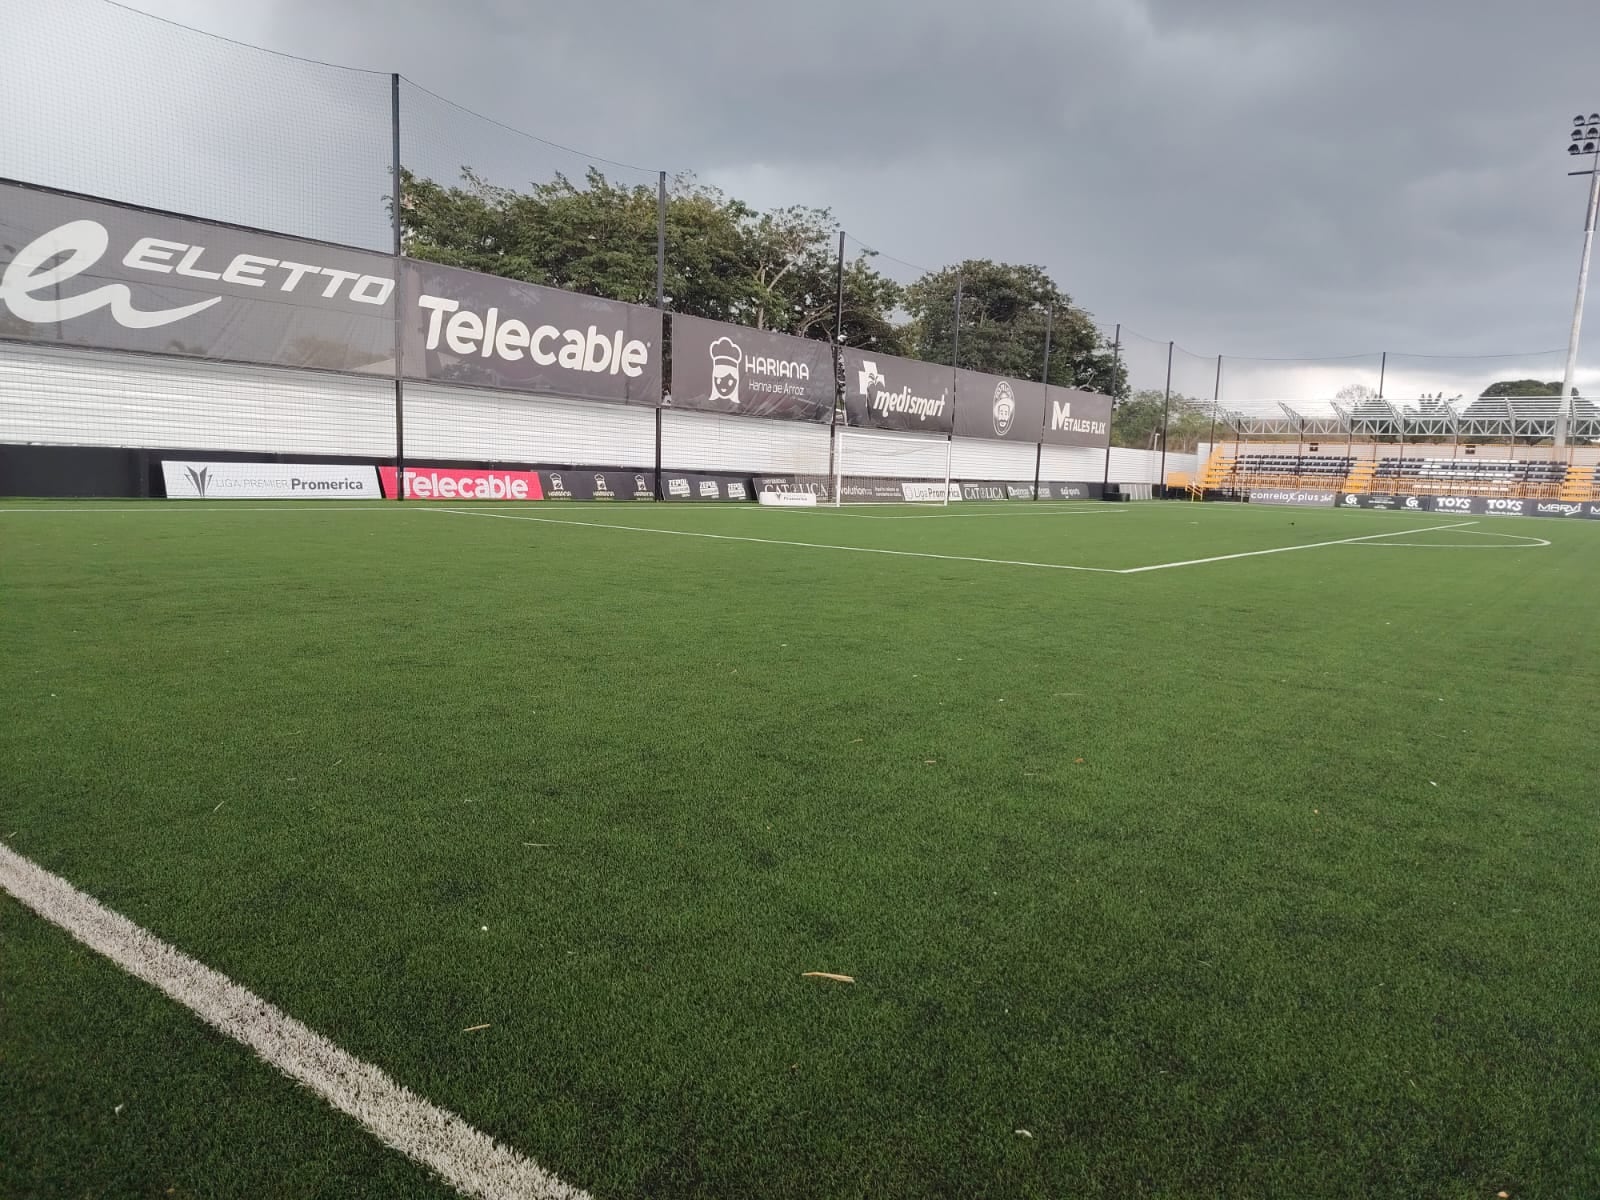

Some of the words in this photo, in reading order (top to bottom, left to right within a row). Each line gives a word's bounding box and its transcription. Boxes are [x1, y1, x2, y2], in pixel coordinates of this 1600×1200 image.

[122, 237, 396, 306] ELETTO
[418, 294, 649, 378] Telecable
[745, 355, 809, 380] HARIANA
[783, 382, 805, 396] Arroz
[873, 385, 946, 421] medismart
[1051, 400, 1091, 433] METALES
[291, 477, 363, 491] Promerica
[395, 471, 529, 499] Telecable
[836, 485, 866, 496] volution
[1298, 493, 1319, 503] plus
[1436, 497, 1472, 509] TOYS
[1487, 499, 1524, 511] TOYS
